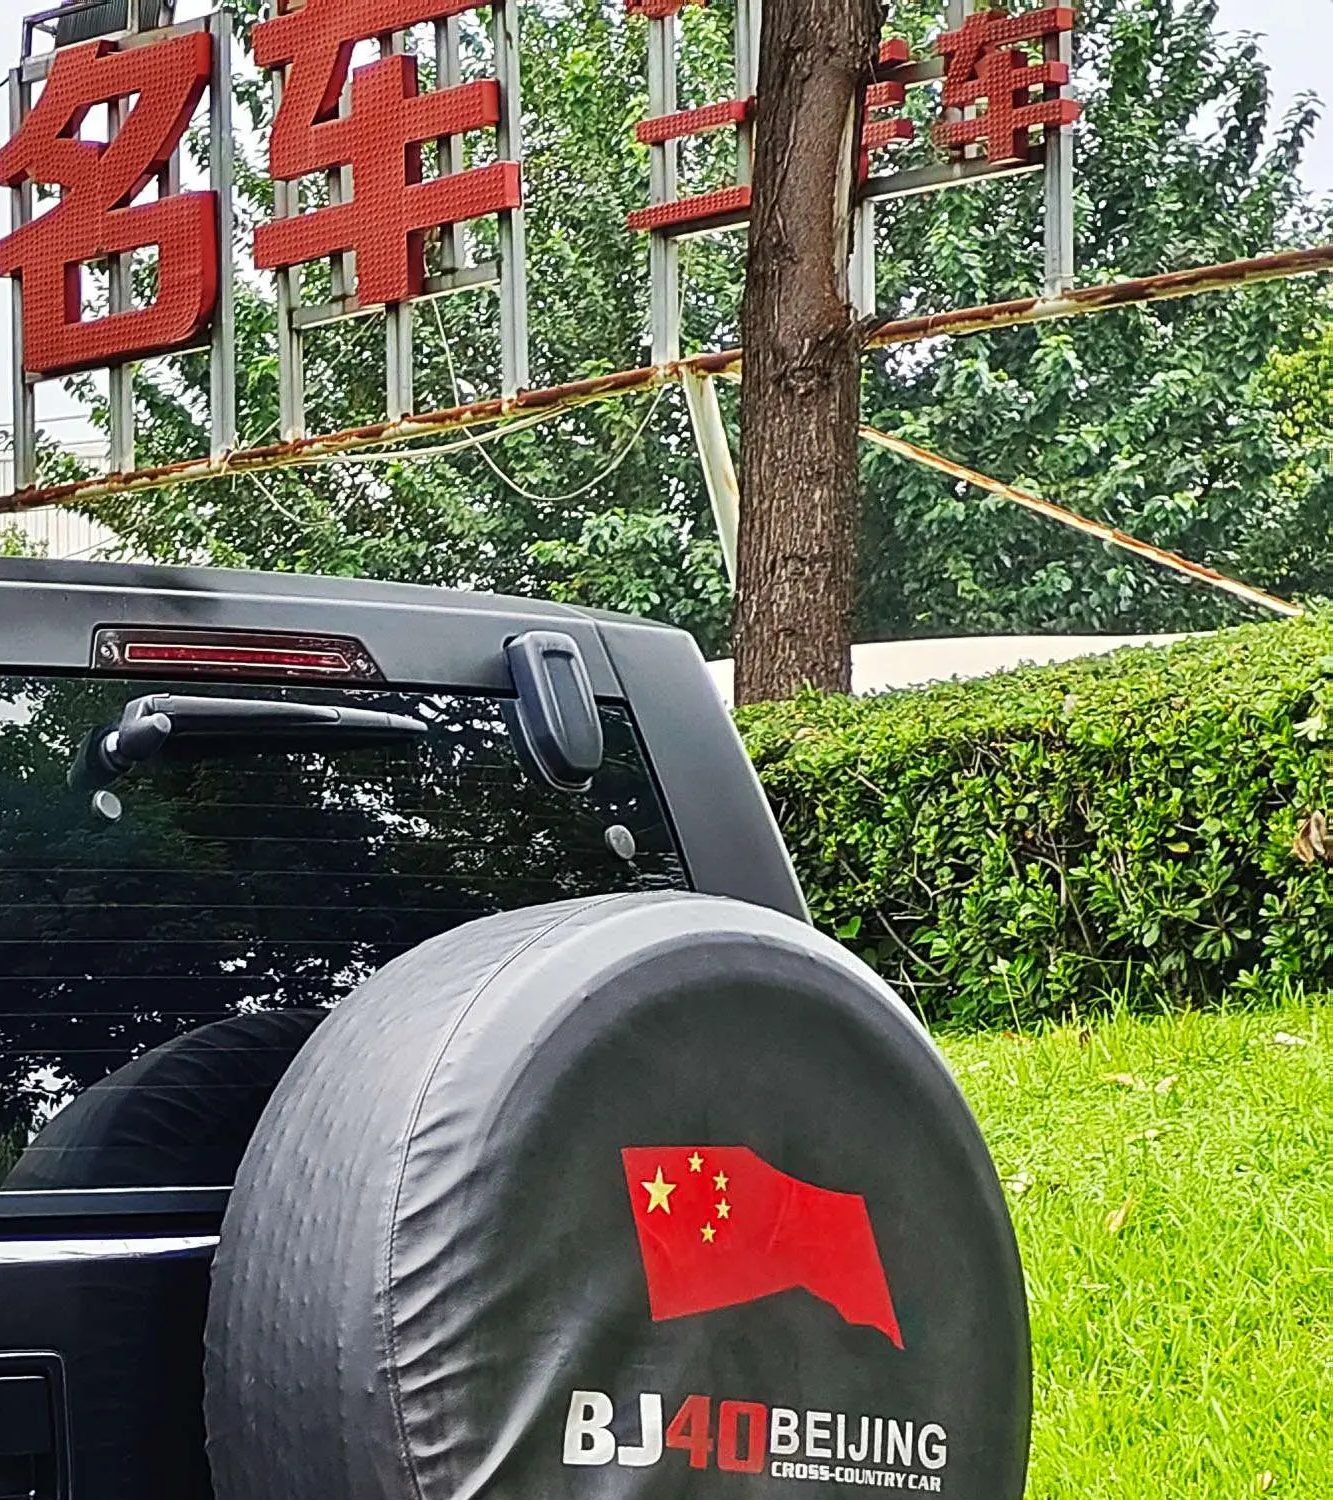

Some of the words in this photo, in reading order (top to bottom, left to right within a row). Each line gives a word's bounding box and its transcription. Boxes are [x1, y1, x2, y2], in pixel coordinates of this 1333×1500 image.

[563, 1390, 768, 1474] BJ40
[770, 1407, 947, 1470] BEIJING
[771, 1461, 908, 1489] CROSS-COUNTRY
[907, 1473, 941, 1492] CAR
